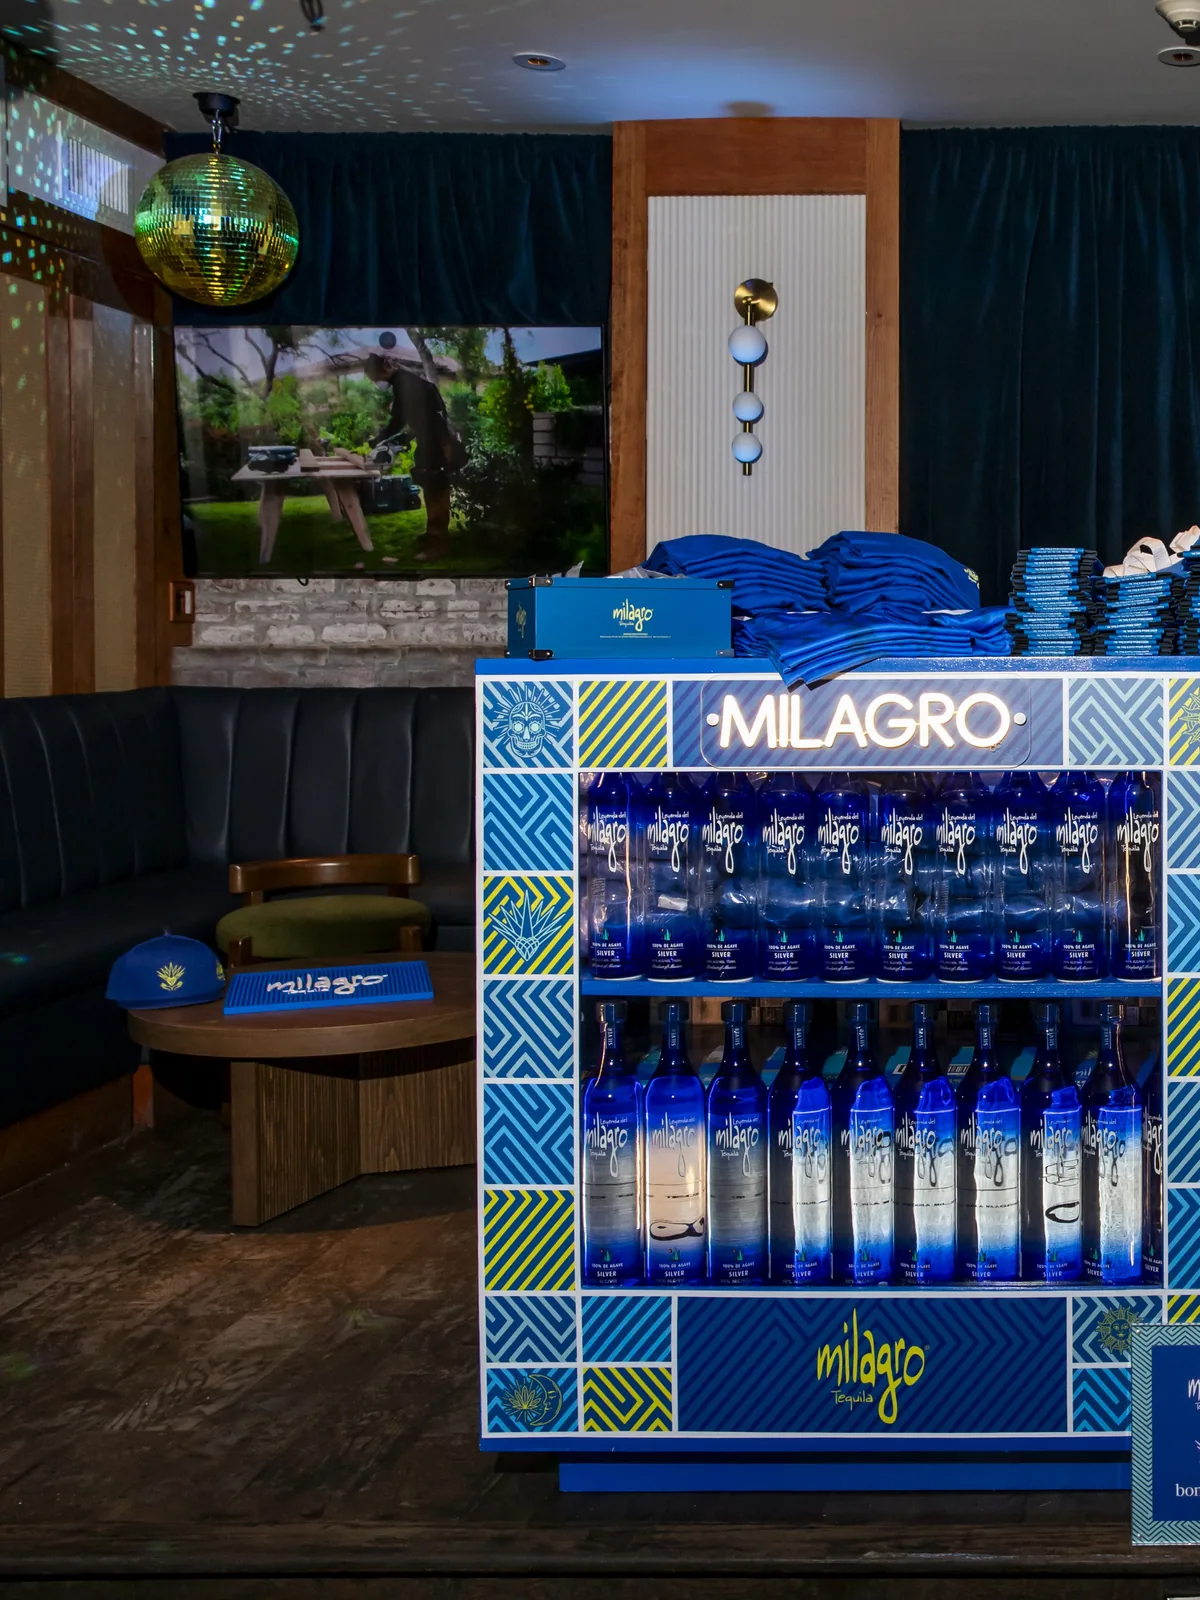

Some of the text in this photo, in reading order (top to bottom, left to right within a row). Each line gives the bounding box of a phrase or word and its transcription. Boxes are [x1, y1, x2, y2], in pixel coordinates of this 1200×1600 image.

[612, 599, 652, 632] milagro
[719, 692, 1011, 749] MILAGRO
[588, 806, 626, 872] milagro
[648, 805, 689, 872] milagro
[702, 806, 743, 873] milagro
[763, 808, 805, 874] milagro
[818, 807, 859, 874] milagro
[881, 808, 922, 875] milagro
[936, 807, 975, 875] milagro
[997, 807, 1037, 874] milagro
[1056, 807, 1098, 874] milagro
[1117, 806, 1158, 872] milagro
[267, 973, 388, 994] milagro
[586, 1112, 627, 1177] milagro
[652, 1112, 695, 1177] milagro
[716, 1112, 759, 1177] milagro
[778, 1112, 821, 1178] milagro
[841, 1114, 884, 1177] milagro
[895, 1112, 936, 1179] milagro
[961, 1112, 1002, 1179] milagro
[1030, 1113, 1072, 1178] milagro
[817, 1308, 925, 1424] milagro
[831, 1389, 874, 1411] Tequila
